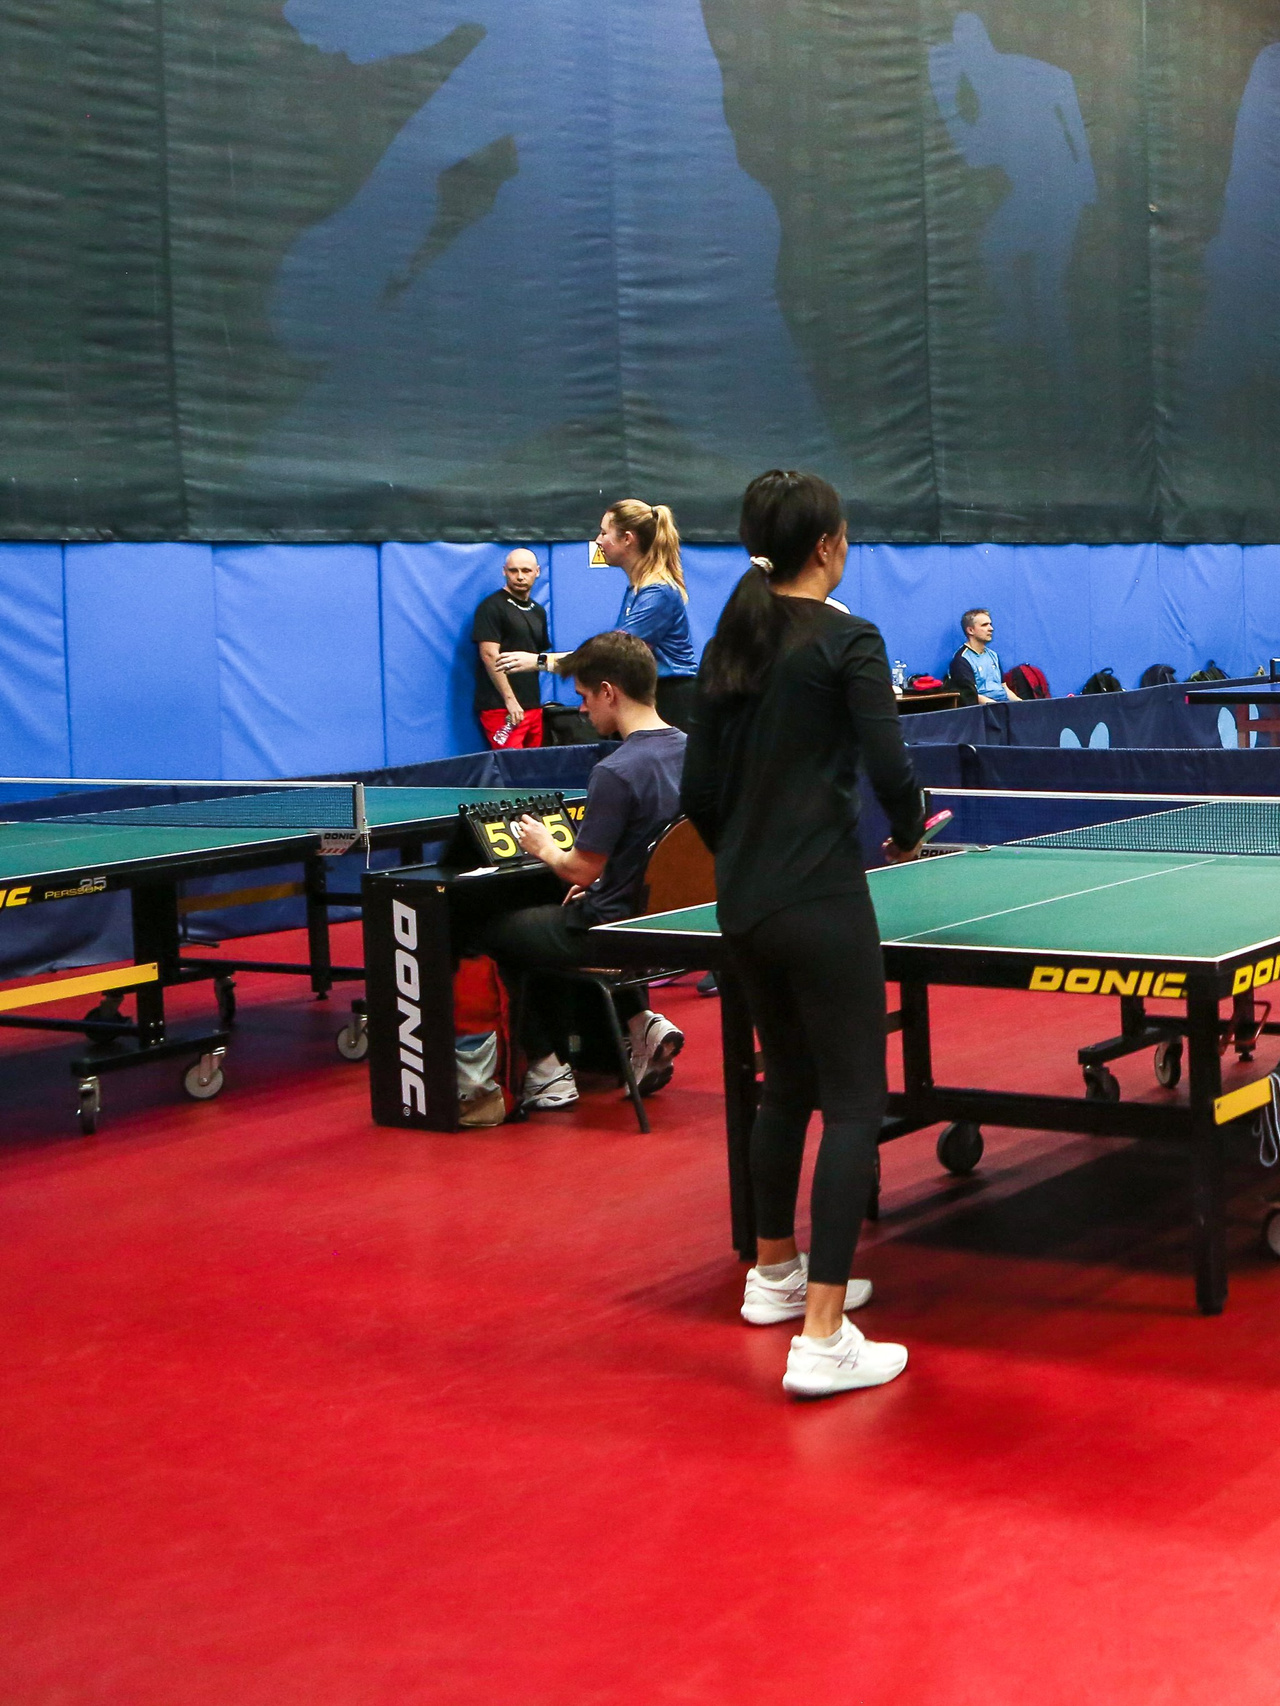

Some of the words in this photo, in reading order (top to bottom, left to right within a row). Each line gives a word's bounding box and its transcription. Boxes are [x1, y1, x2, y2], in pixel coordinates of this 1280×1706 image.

[323, 832, 356, 840] DONIC
[484, 821, 518, 858] 5
[542, 813, 575, 850] 5
[1029, 966, 1187, 998] DONIC
[392, 898, 427, 1117] DONIC
